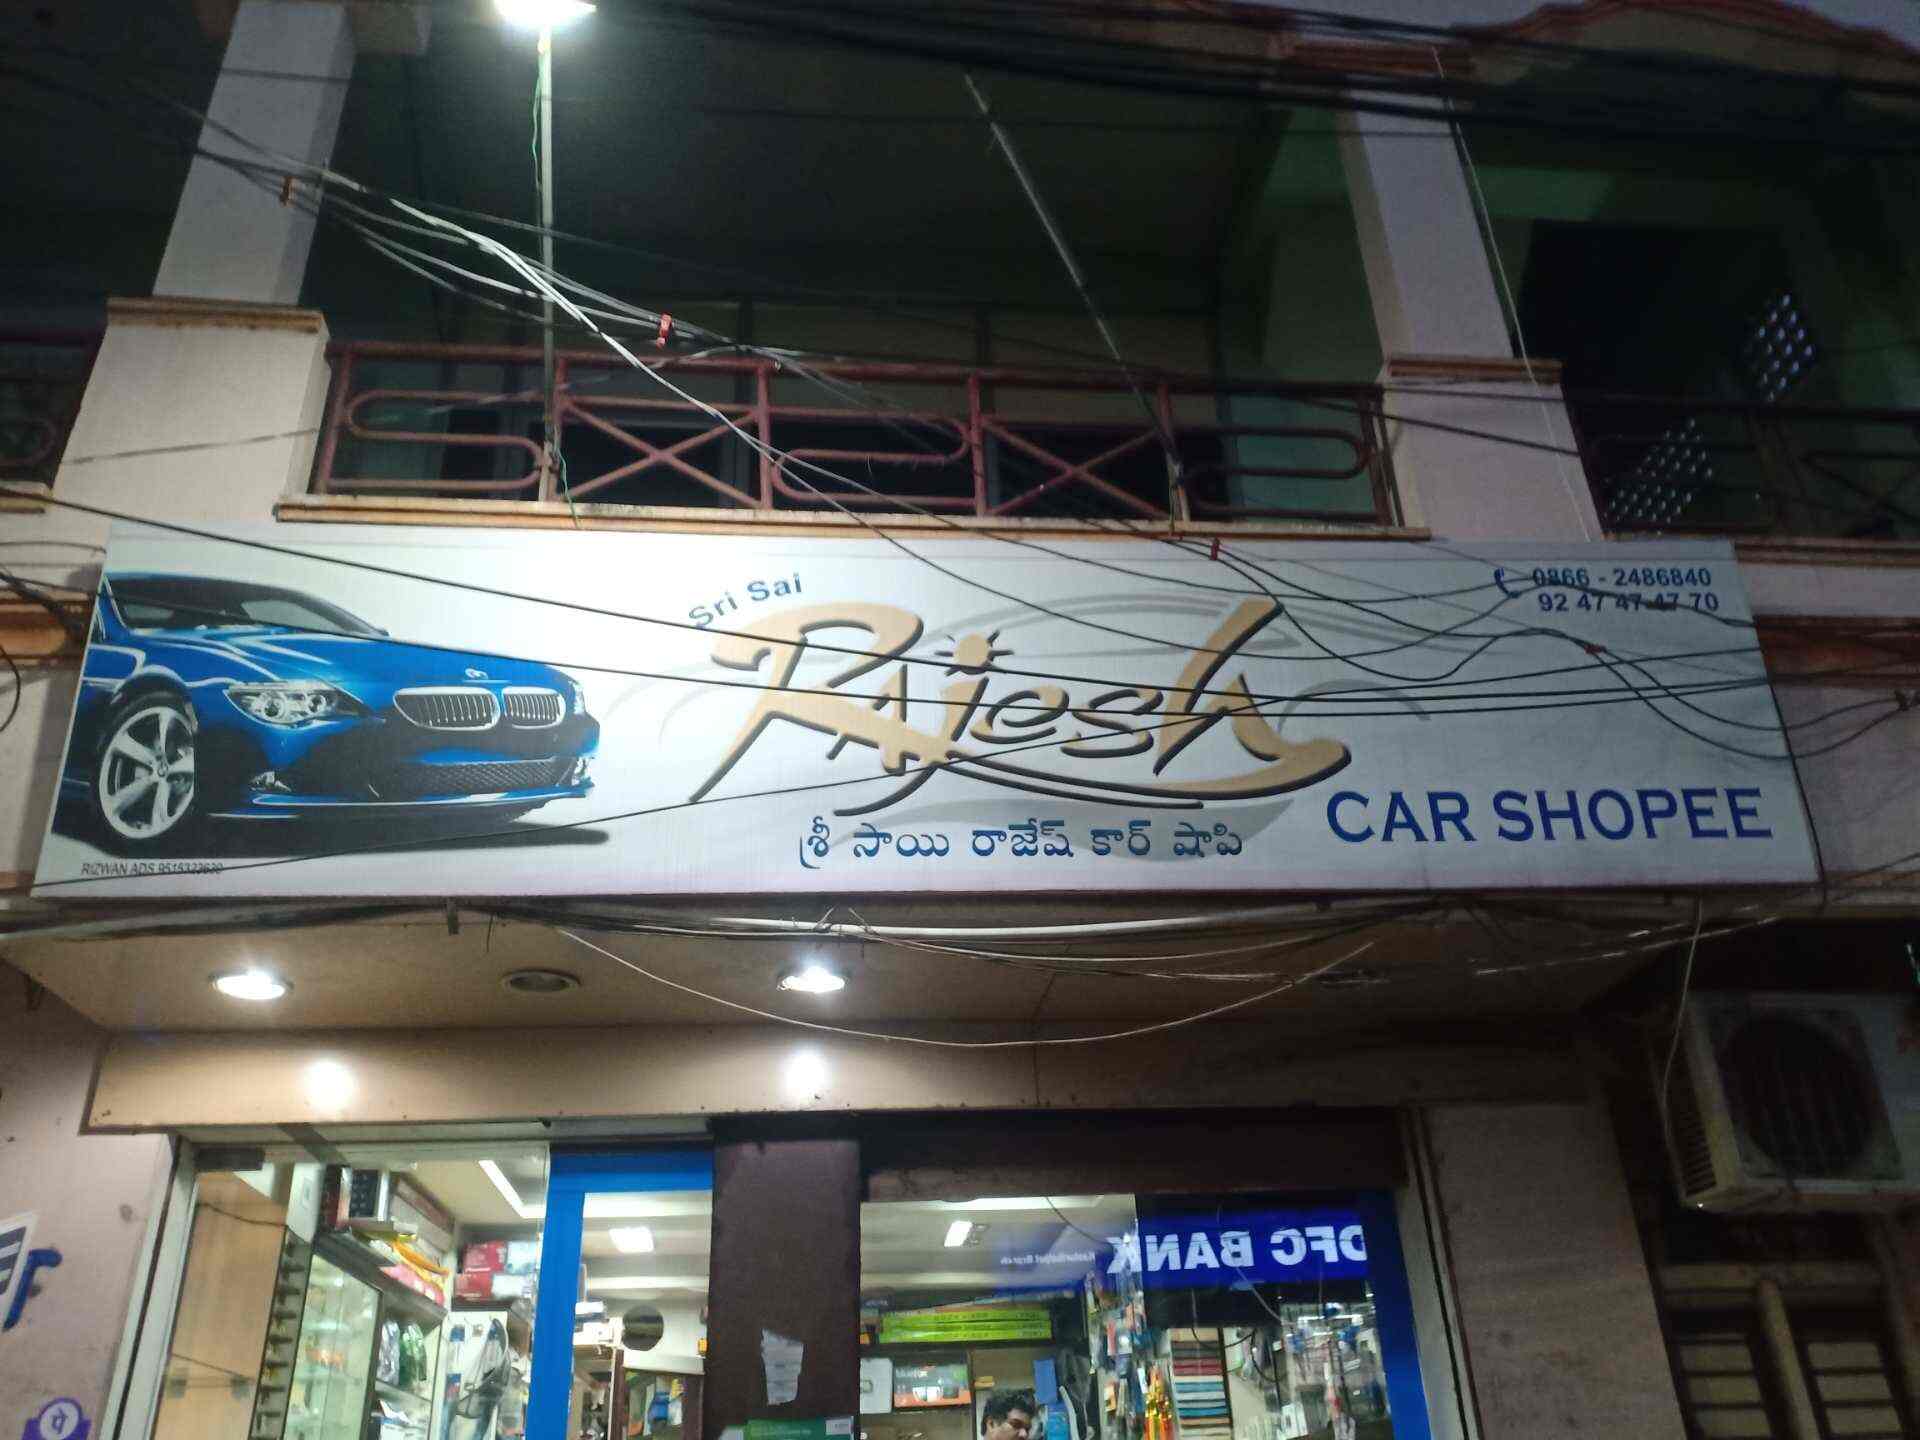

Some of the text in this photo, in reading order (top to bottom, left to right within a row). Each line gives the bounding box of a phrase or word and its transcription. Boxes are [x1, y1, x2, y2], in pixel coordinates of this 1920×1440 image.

[1532, 568, 1590, 586] 0866
[1613, 568, 1712, 586] 2486840
[688, 572, 801, 629] Sri Sai
[1538, 593, 1569, 612] 92
[1688, 592, 1719, 612] 70
[1326, 787, 1773, 843] CAR SHOPEE
[800, 816, 830, 870] శ్రీ
[852, 823, 951, 858] సాయి
[972, 818, 1074, 858] రాజేష్
[1091, 820, 1151, 857] కార్
[81, 862, 127, 876] RIZWAN
[131, 862, 155, 875] ADS
